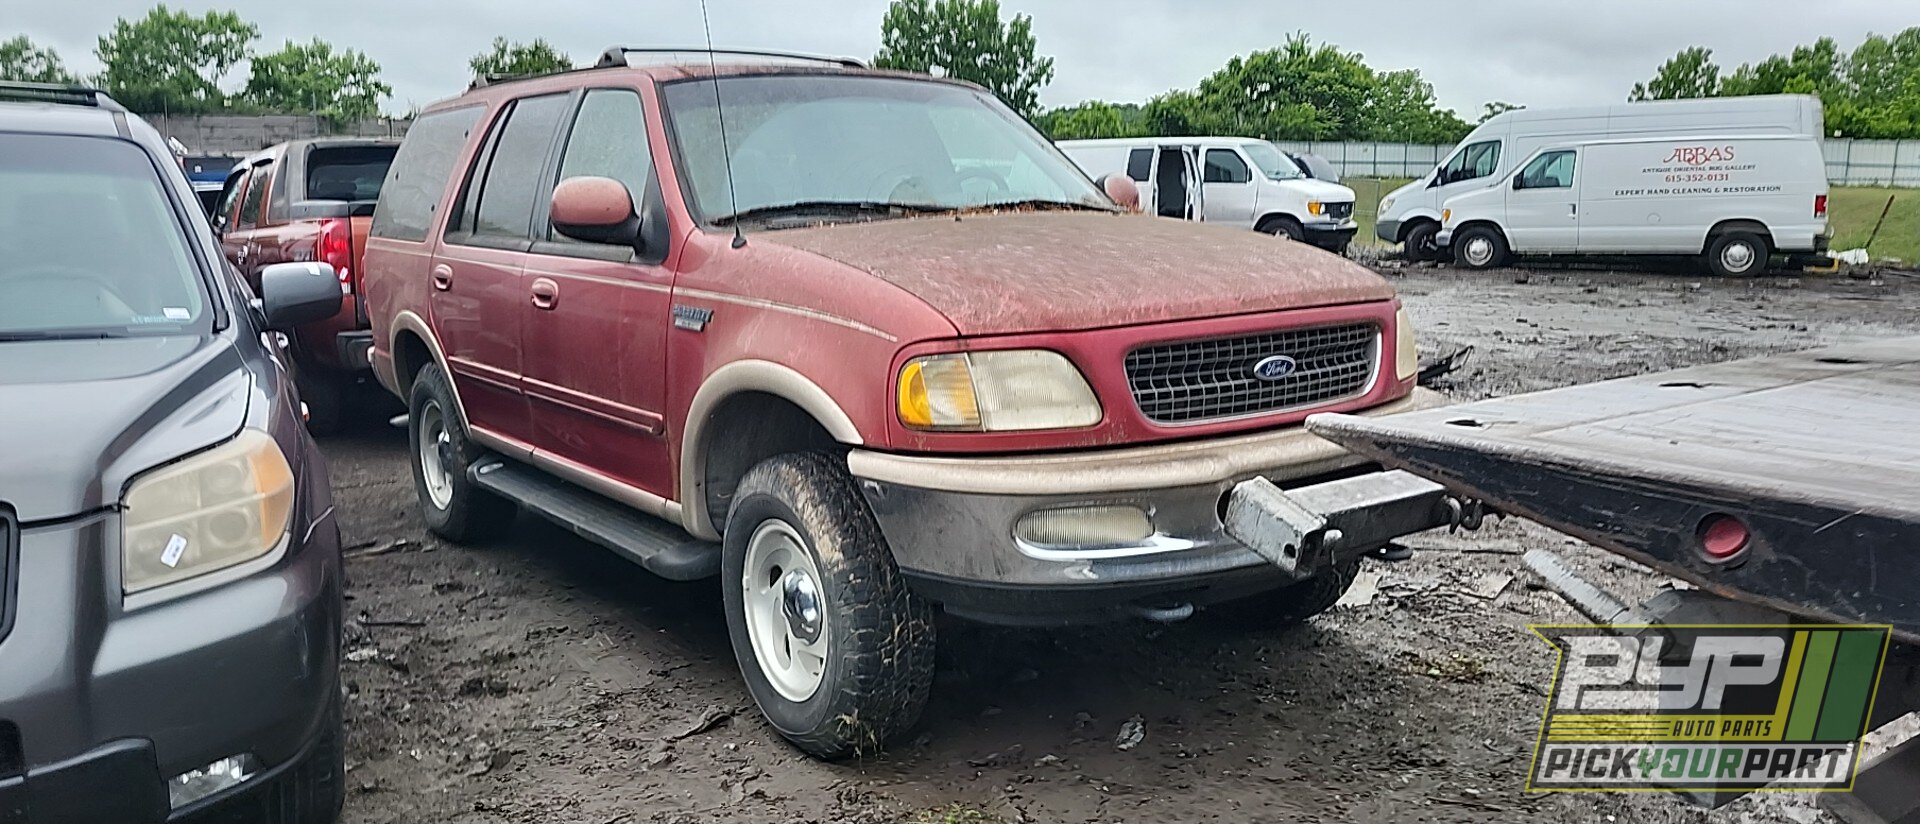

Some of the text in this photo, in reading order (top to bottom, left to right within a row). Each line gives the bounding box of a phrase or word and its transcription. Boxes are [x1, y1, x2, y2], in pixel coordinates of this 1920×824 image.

[1663, 146, 1735, 165] ABBAS
[1665, 173, 1730, 183] 615-352-0131
[1672, 187, 1711, 195] CLEANING
[1723, 185, 1782, 193] RESTORATION
[1265, 360, 1289, 377] Ford
